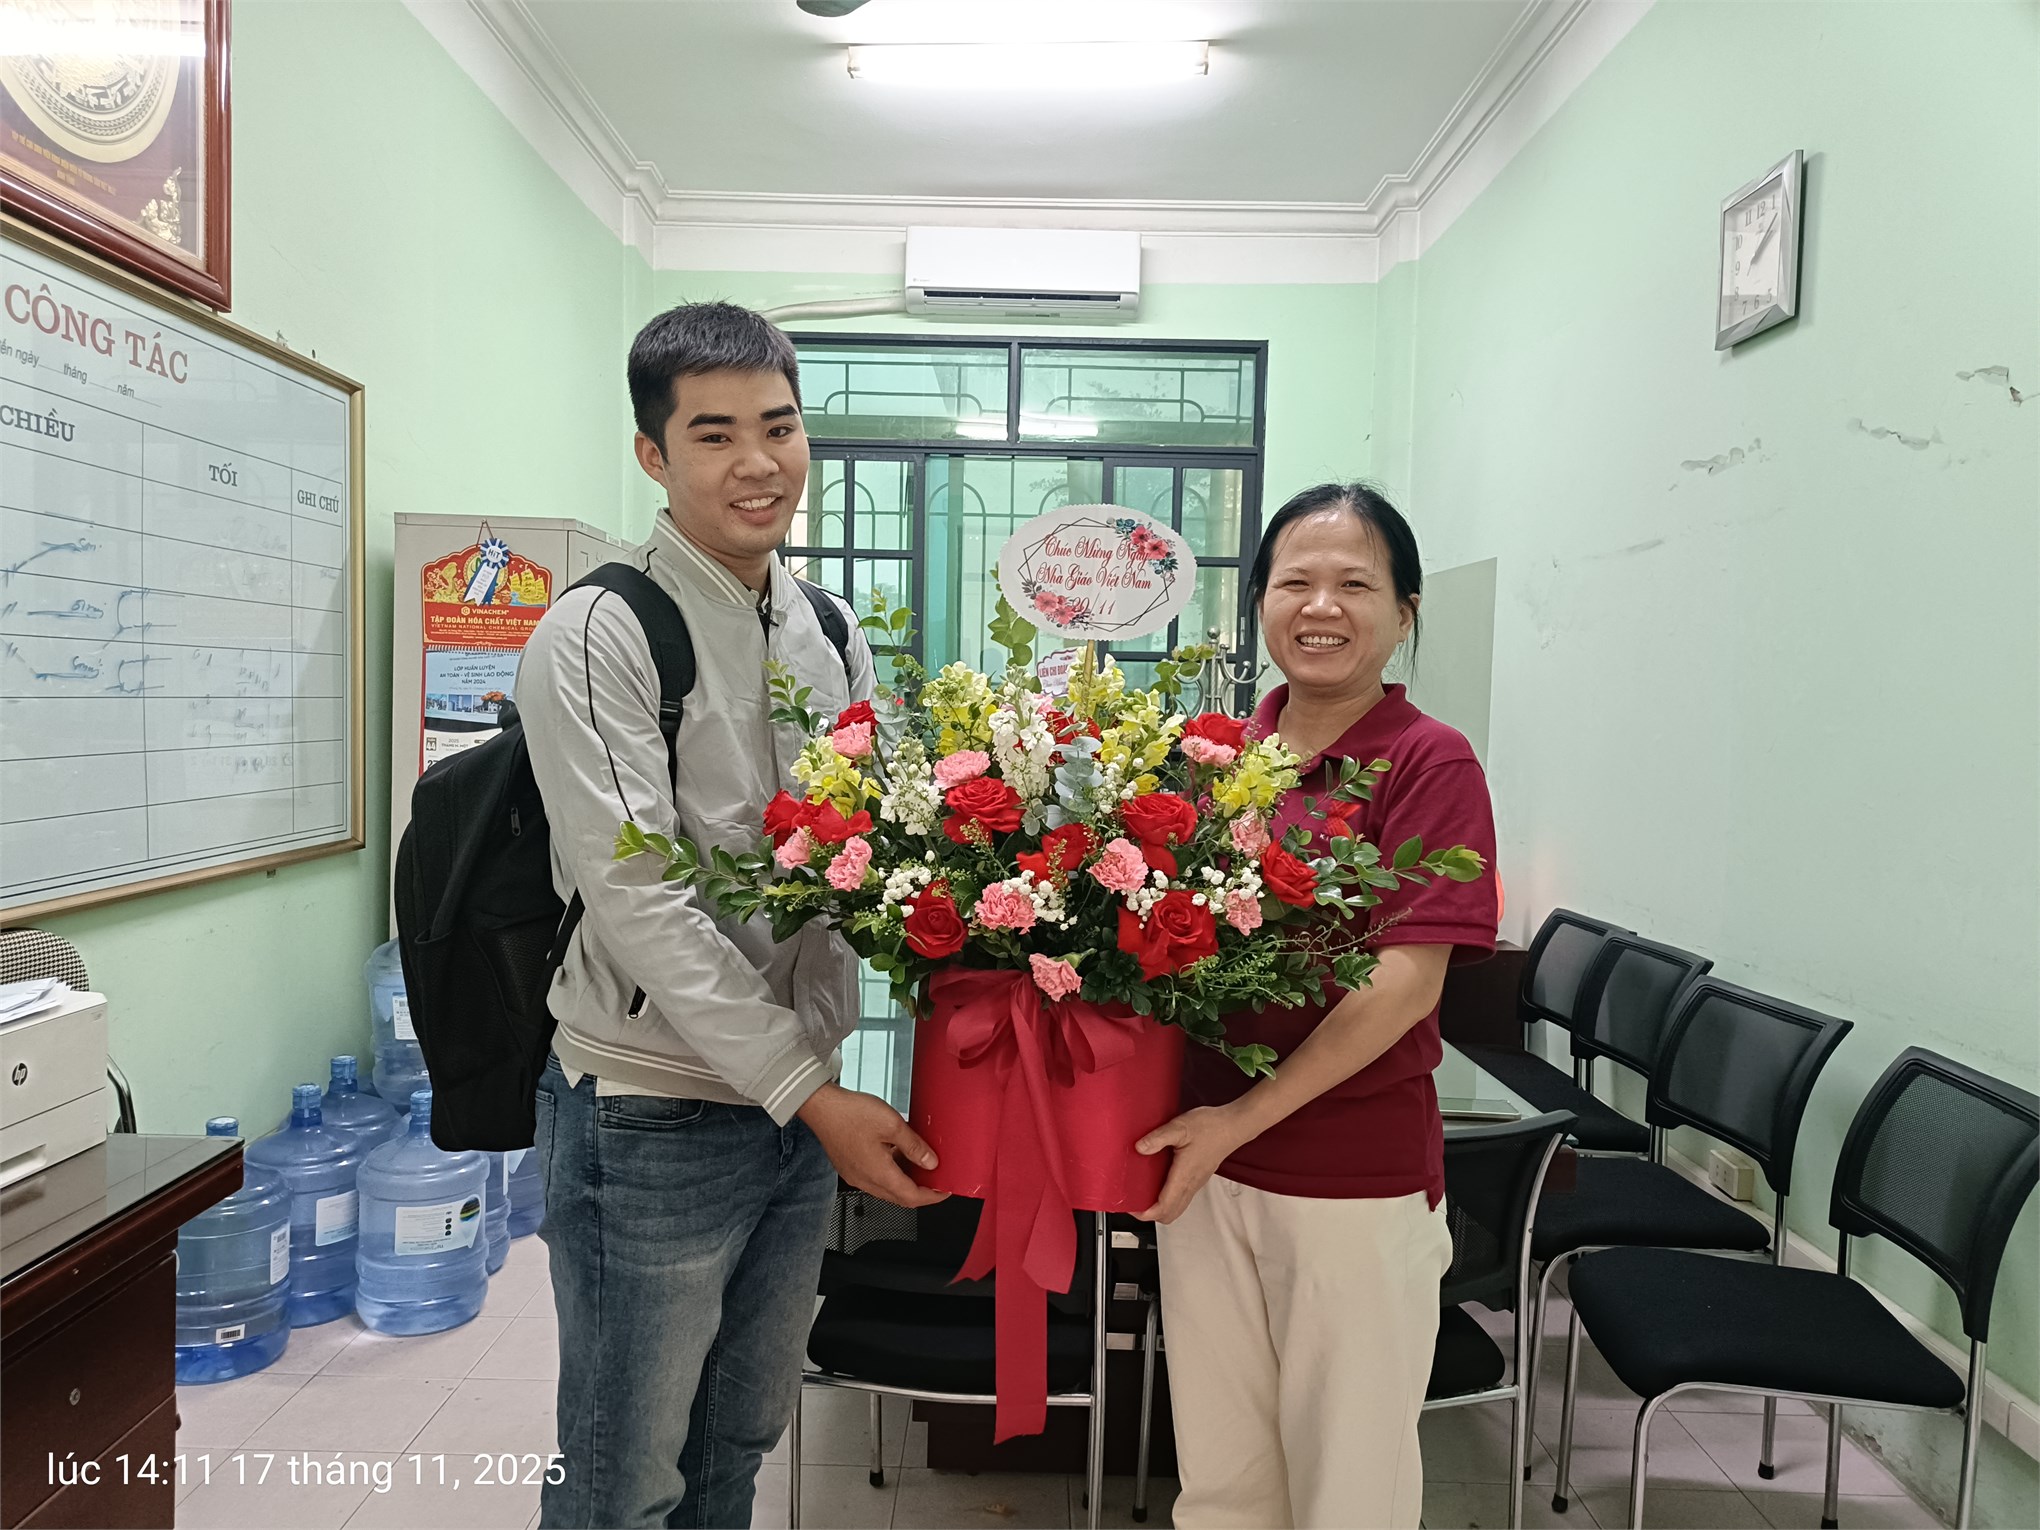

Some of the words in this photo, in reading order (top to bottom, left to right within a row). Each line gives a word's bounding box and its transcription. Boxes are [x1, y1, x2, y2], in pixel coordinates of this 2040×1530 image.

[1756, 200, 1766, 220] 12
[1735, 260, 1741, 276] 9
[1742, 300, 1748, 316] 7
[1753, 294, 1760, 310] 6
[5, 283, 115, 357] CÔNG
[125, 331, 188, 384] TÁC
[0, 338, 13, 357] ến
[15, 349, 40, 368] ngày
[63, 363, 88, 385] tháng
[117, 383, 135, 398] năm
[0, 404, 75, 442] CHIỀU
[208, 462, 238, 487] TỐI
[297, 489, 317, 508] GHI
[319, 495, 340, 513] CHÚ
[1045, 534, 1072, 557] Chúc
[1065, 563, 1093, 591] Giáo
[1121, 567, 1152, 589] Nam
[431, 615, 445, 624] TẬP
[446, 615, 466, 624] ĐOÀN
[484, 616, 504, 625] CHẤT
[505, 618, 522, 626] VIỆT
[496, 670, 514, 678] ĐỘNG
